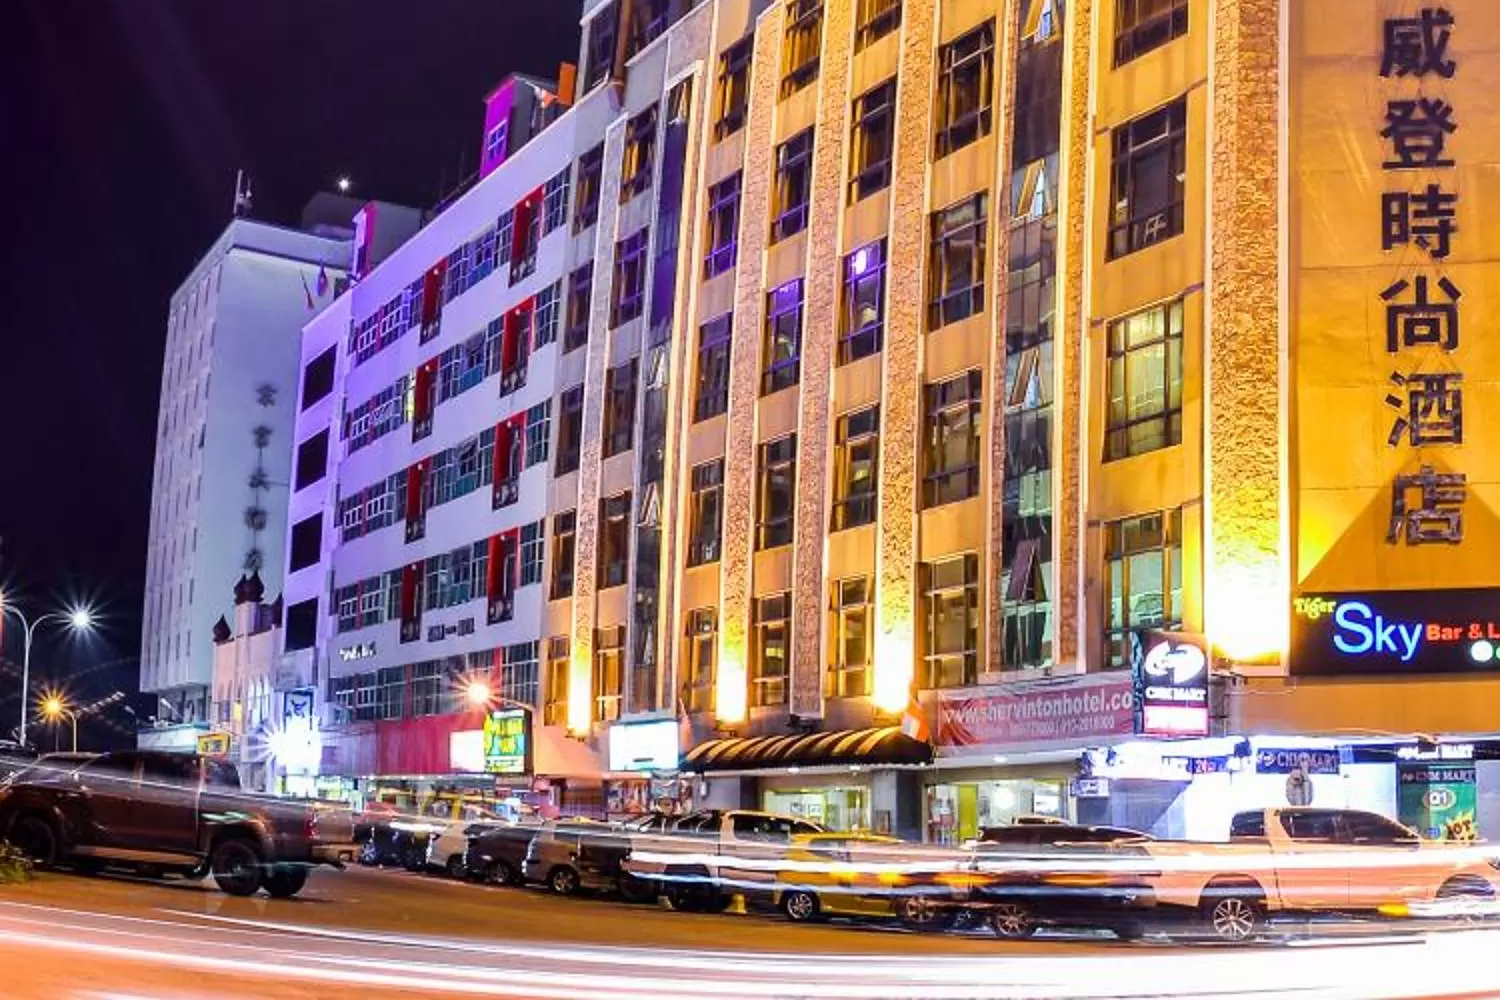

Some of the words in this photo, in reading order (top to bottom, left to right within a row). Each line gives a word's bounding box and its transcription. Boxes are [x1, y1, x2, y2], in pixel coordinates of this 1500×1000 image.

[1295, 598, 1336, 618] Tiger
[1333, 601, 1422, 661] Sky
[1426, 625, 1462, 641] Bar
[1468, 623, 1483, 640] &
